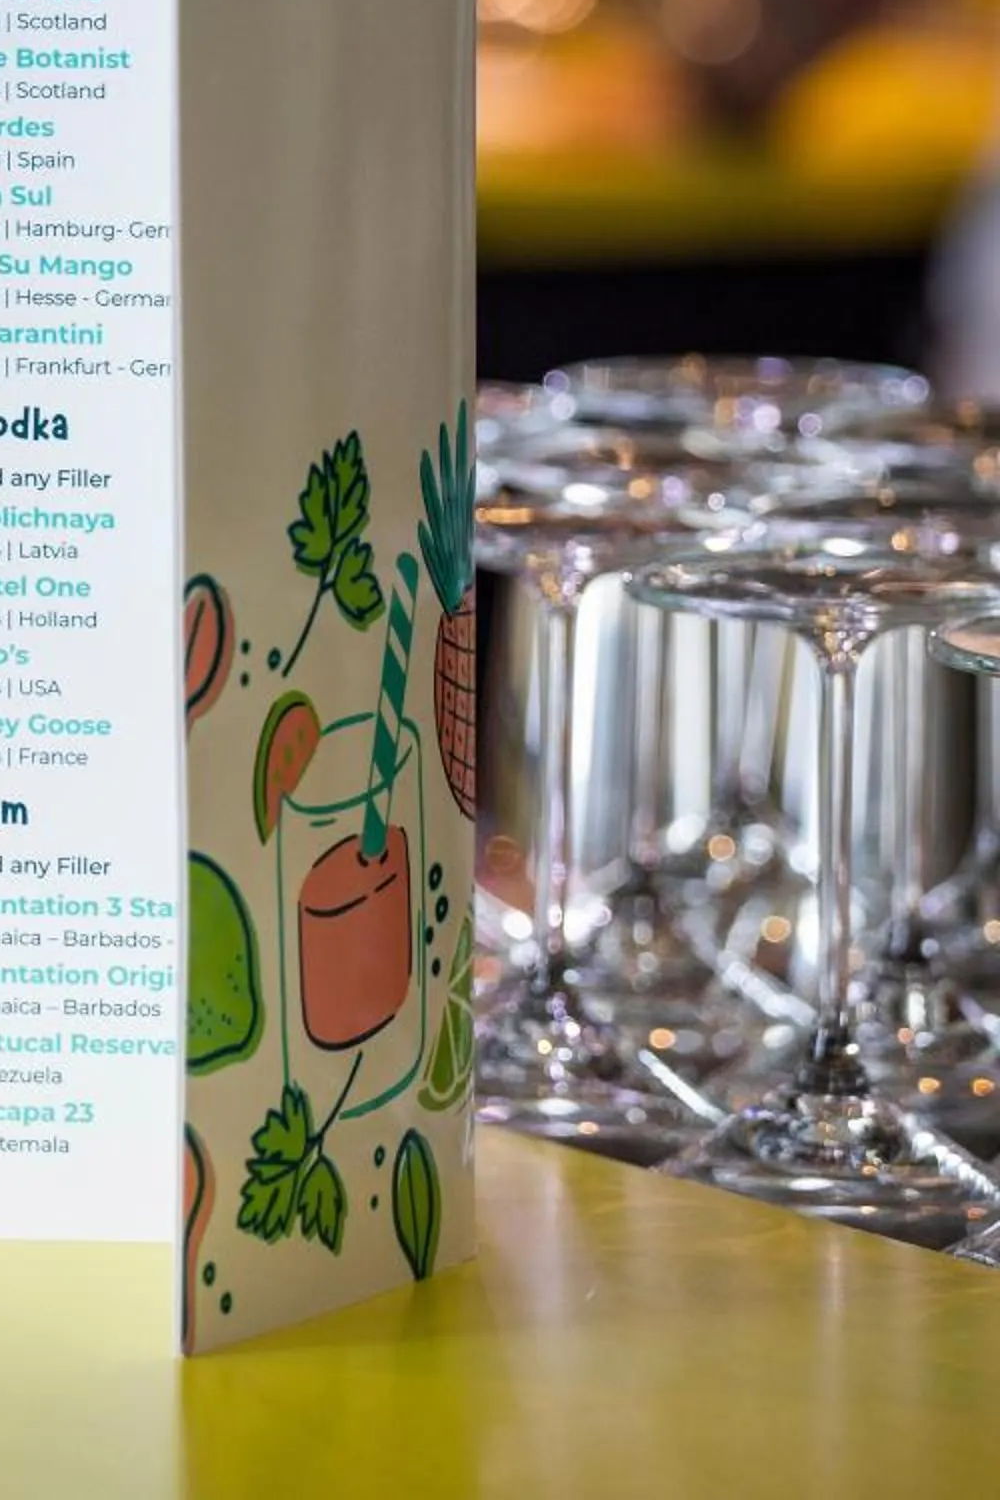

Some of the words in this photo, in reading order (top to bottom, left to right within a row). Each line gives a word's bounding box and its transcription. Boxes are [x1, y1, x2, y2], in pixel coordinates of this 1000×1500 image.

[16, 11, 108, 32] Scotland
[14, 46, 132, 70] Botanist
[15, 80, 106, 100] Scotland
[16, 150, 76, 173] Spain
[9, 183, 54, 208] Sul
[37, 253, 134, 283] Mango
[15, 287, 78, 308] Hesse
[15, 356, 112, 376] Frankfurt
[9, 470, 52, 492] any
[56, 467, 113, 489] Filler
[18, 541, 79, 561] Latvia
[33, 575, 92, 599] One
[18, 610, 98, 629] Holland
[19, 679, 62, 698] USA
[26, 712, 113, 737] Goose
[18, 747, 89, 766] France
[9, 859, 52, 880] any
[57, 855, 112, 877] Filler
[106, 896, 123, 918] 3
[63, 929, 163, 950] Barbados
[106, 964, 174, 993] Origi
[63, 998, 162, 1018] Barbados
[70, 1033, 176, 1056] Reserva
[63, 1101, 95, 1124] 23
